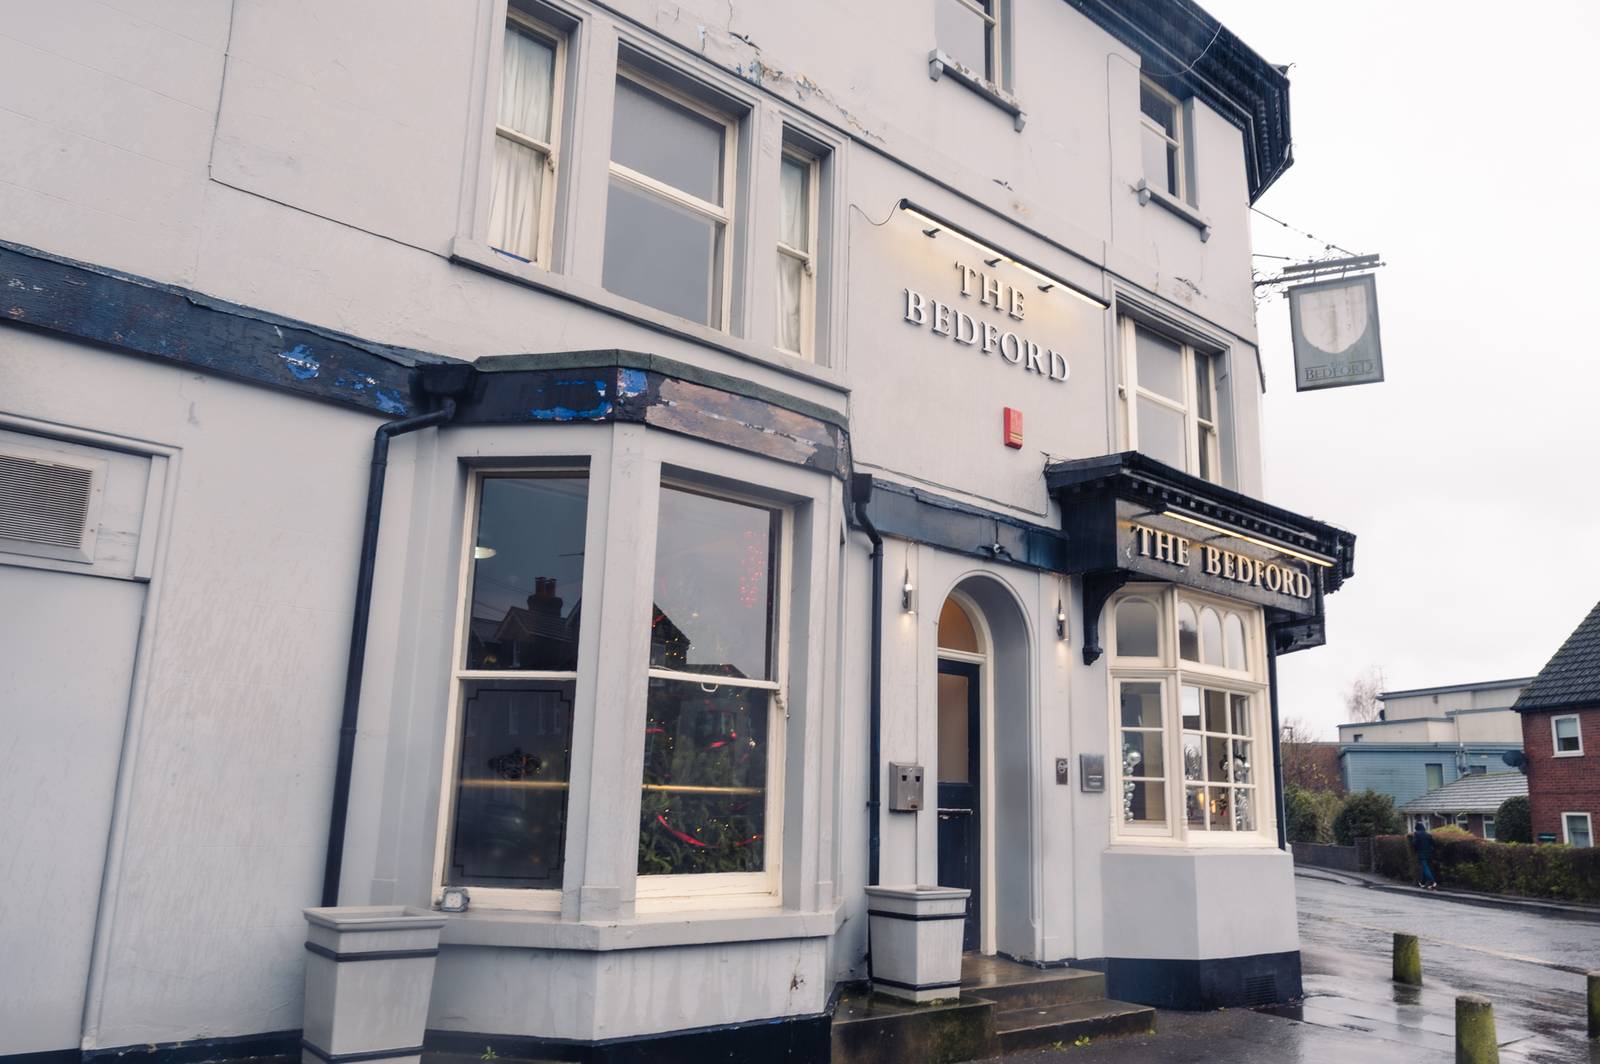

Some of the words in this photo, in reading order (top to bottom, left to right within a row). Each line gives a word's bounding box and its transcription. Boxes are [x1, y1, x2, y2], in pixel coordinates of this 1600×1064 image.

[955, 262, 1025, 320] THE
[904, 287, 1070, 382] BEDFORD
[1133, 524, 1190, 567] THE
[1203, 545, 1312, 599] BEDFORD
